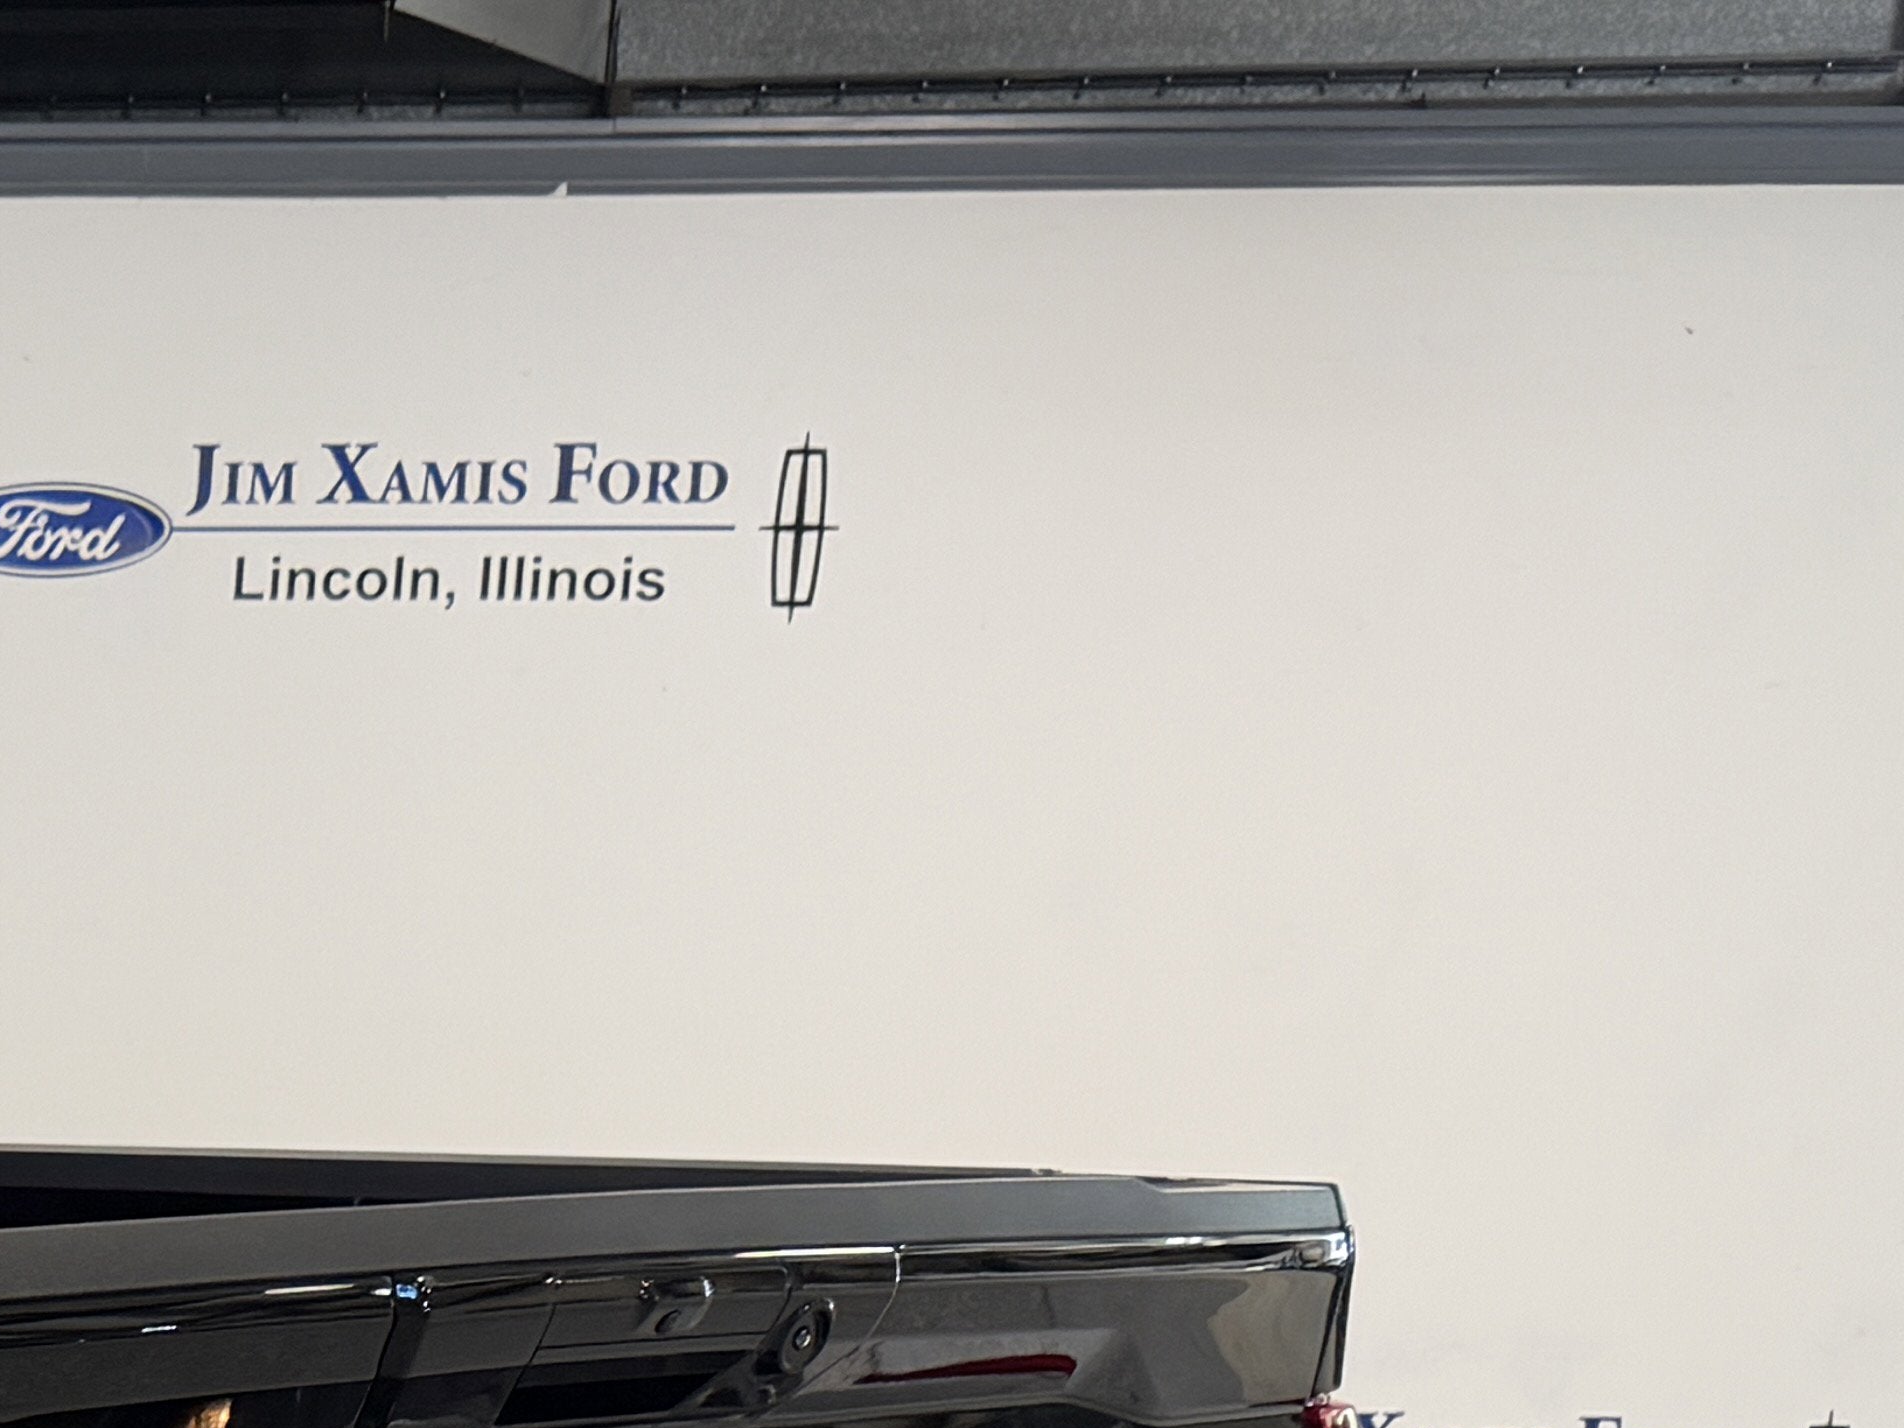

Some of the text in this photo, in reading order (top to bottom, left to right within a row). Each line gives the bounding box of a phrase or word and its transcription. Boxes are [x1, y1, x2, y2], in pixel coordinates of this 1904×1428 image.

[186, 443, 730, 516] JIM XAMIS FORD
[233, 555, 667, 611] Lincoln, Illinois
